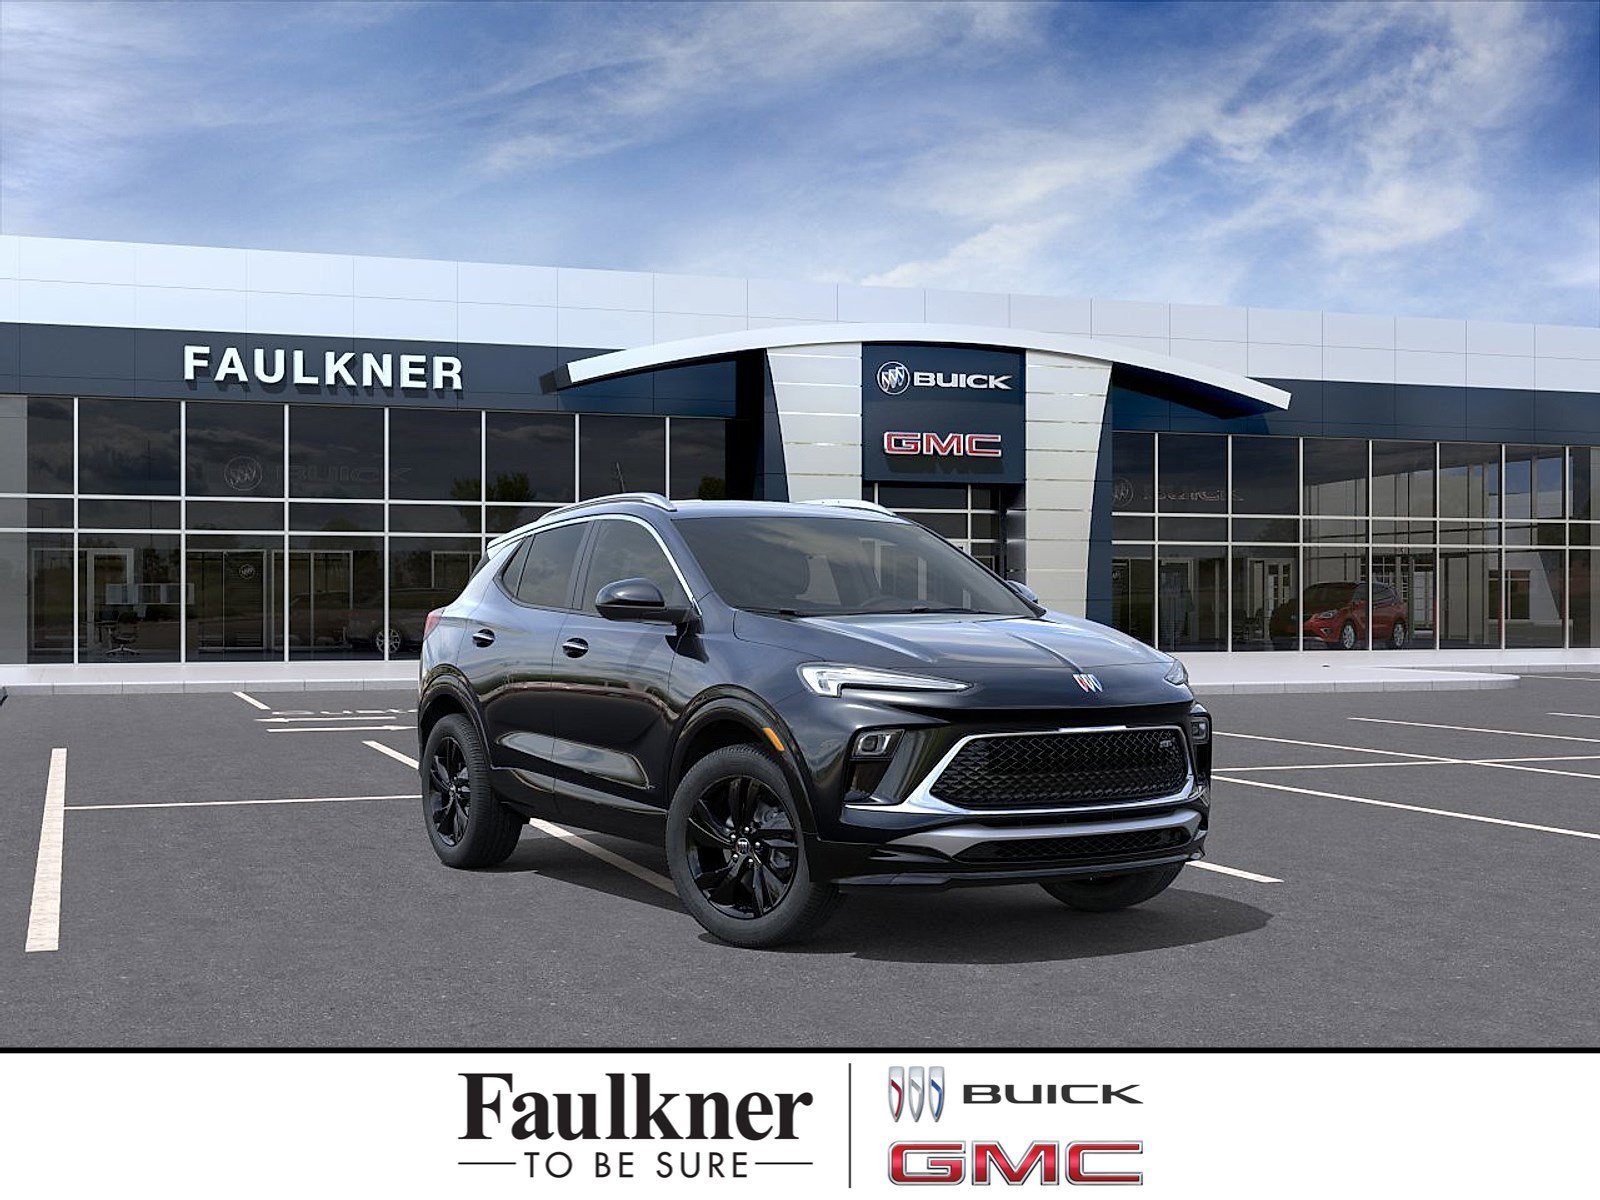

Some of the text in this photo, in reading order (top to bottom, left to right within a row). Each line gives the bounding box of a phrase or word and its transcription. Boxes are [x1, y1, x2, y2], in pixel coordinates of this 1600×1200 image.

[183, 345, 463, 390] FAULKNER
[913, 371, 1013, 390] BUICK
[884, 431, 1002, 457] GMC
